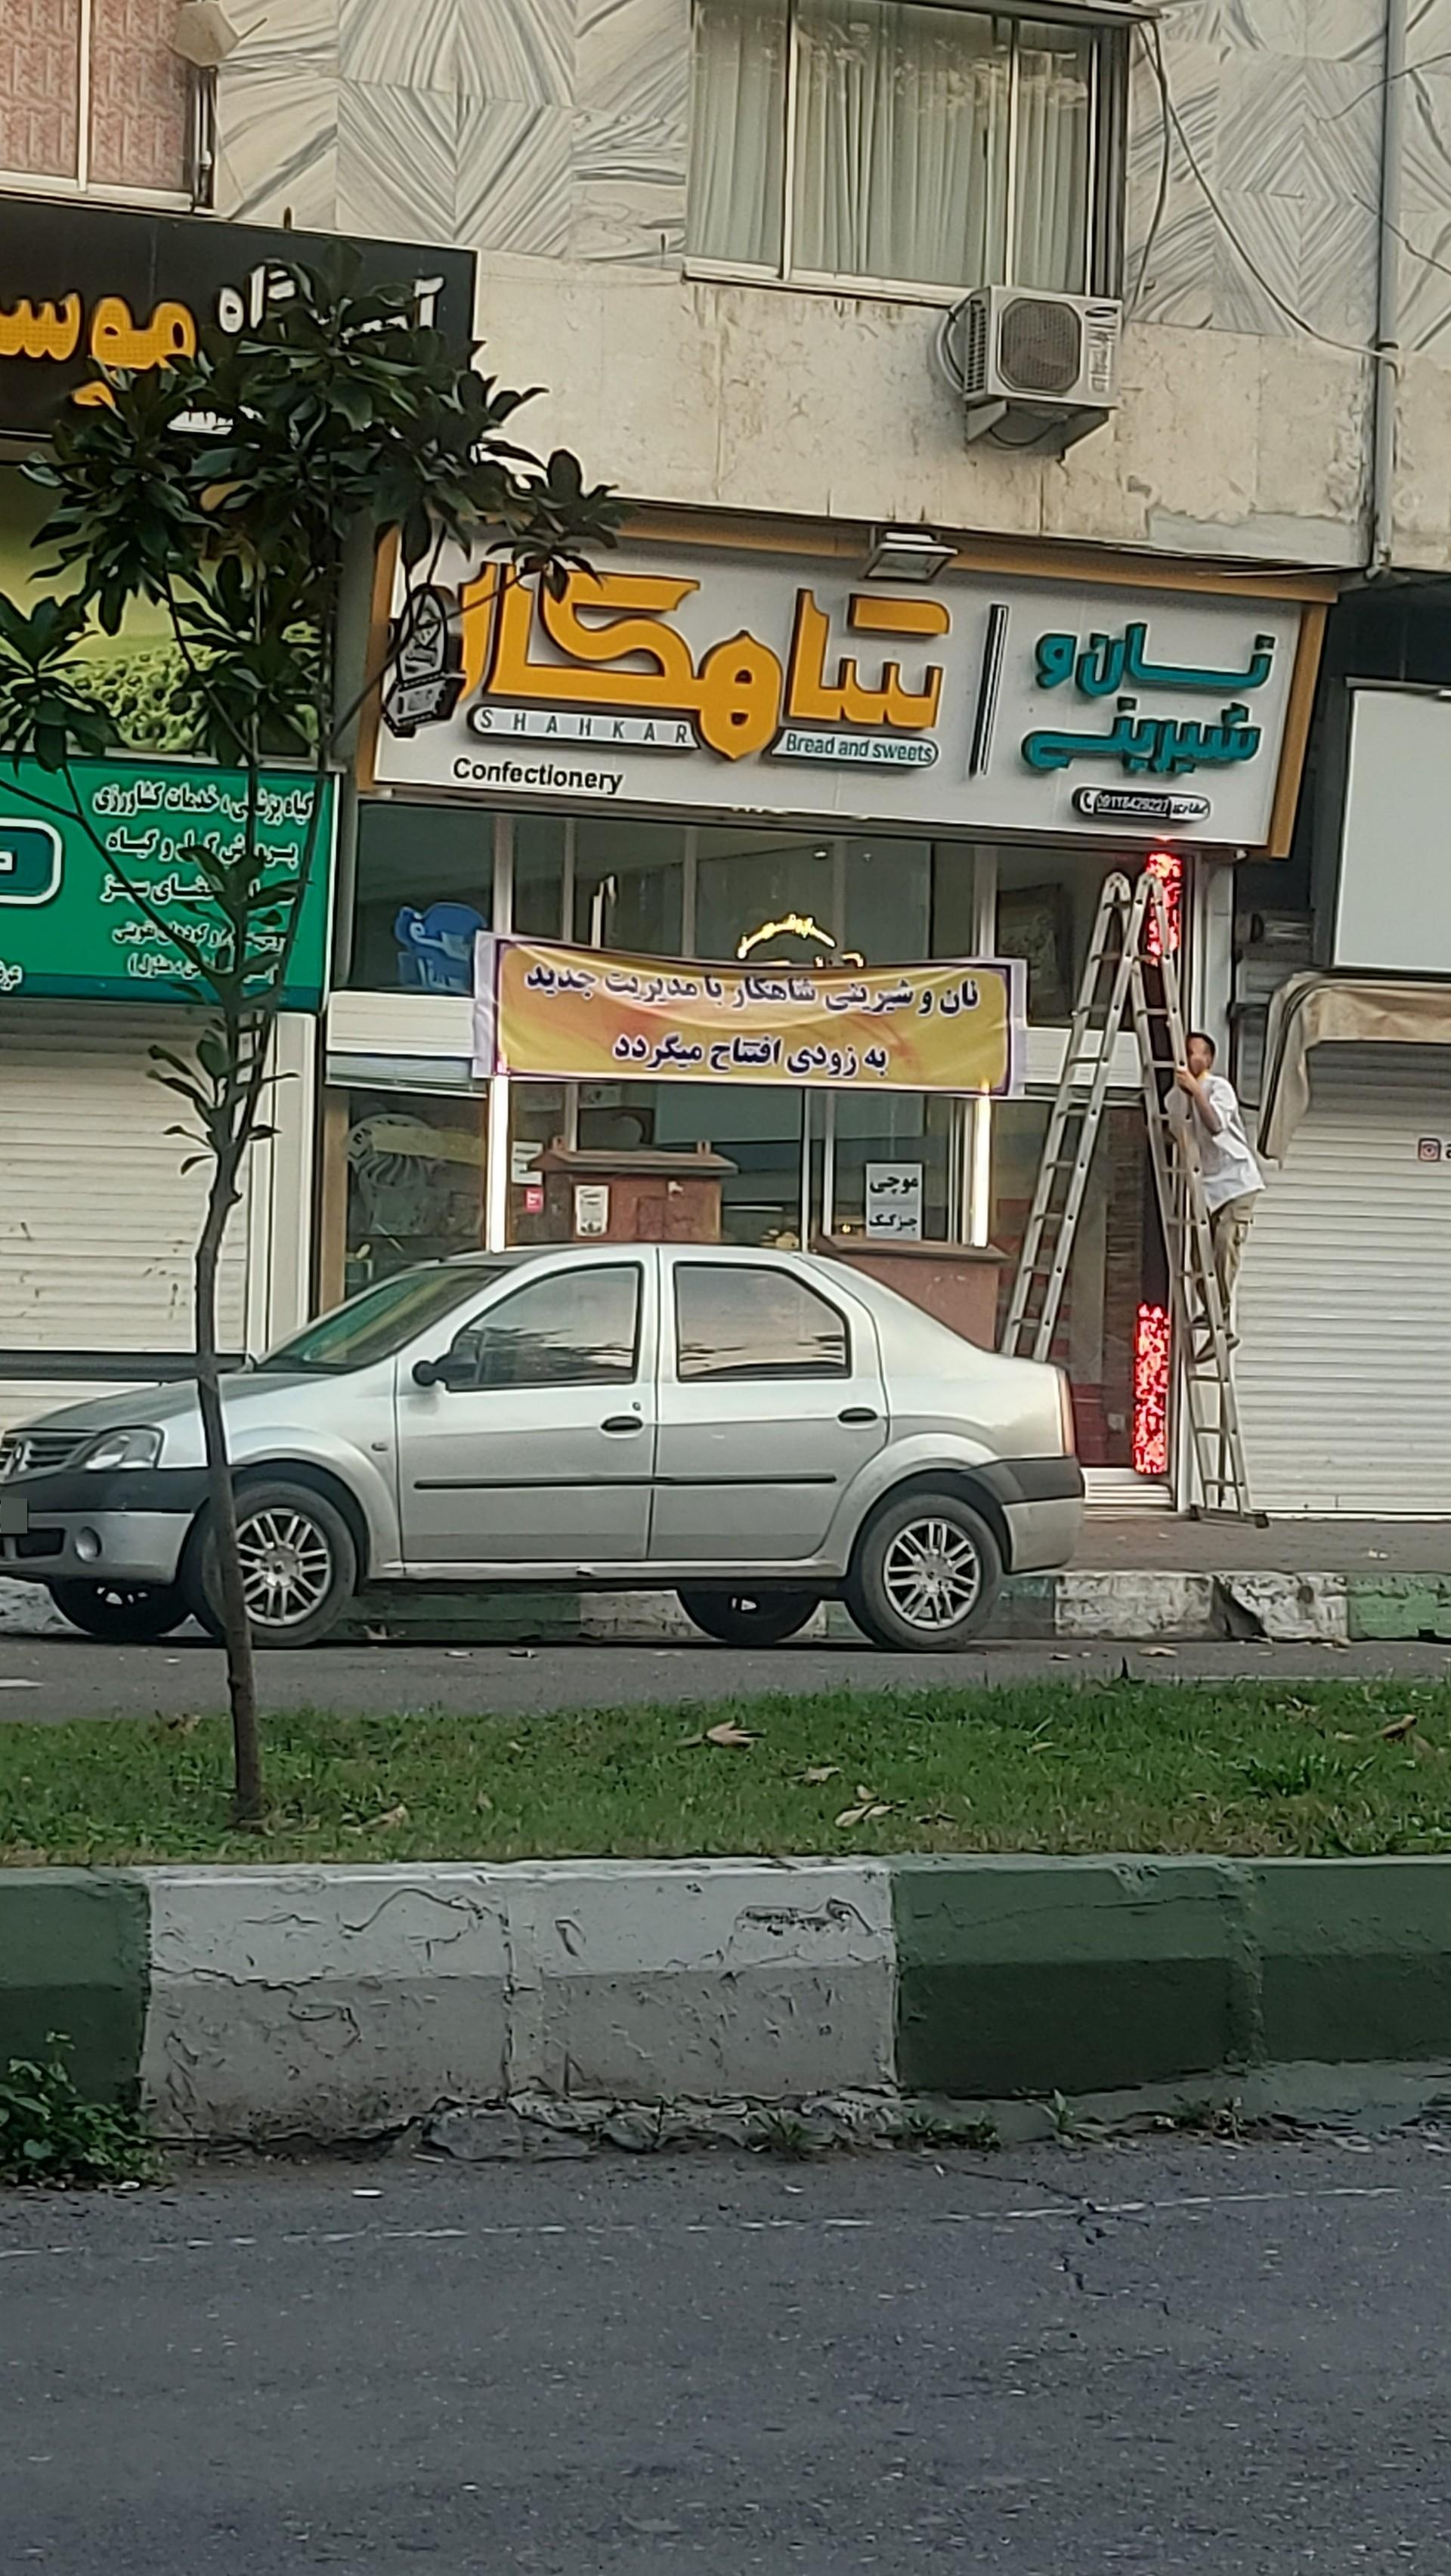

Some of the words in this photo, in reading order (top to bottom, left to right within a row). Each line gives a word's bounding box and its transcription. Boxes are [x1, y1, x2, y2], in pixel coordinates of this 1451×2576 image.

[458, 561, 952, 760] شاهکار
[1034, 631, 1078, 689] و
[1074, 621, 1276, 697] نان
[479, 708, 688, 744] SHAHKAR
[1021, 695, 1262, 774] شیرینی
[786, 732, 835, 754] Bread
[838, 740, 870, 757] and
[872, 742, 933, 763] sweets
[453, 757, 623, 795] Confectionery
[221, 790, 282, 826] پزشی،
[527, 966, 597, 998] جدید
[605, 972, 698, 1003] مدیریت
[704, 974, 723, 1006] با
[732, 976, 817, 1008] شاهکار
[825, 979, 914, 1013] شیرینی
[939, 979, 979, 1014] نان
[917, 990, 933, 1015] و
[614, 1034, 704, 1068] میگردد
[710, 1035, 781, 1071] افتتاح
[787, 1044, 857, 1078] زودی
[862, 1047, 887, 1077] به
